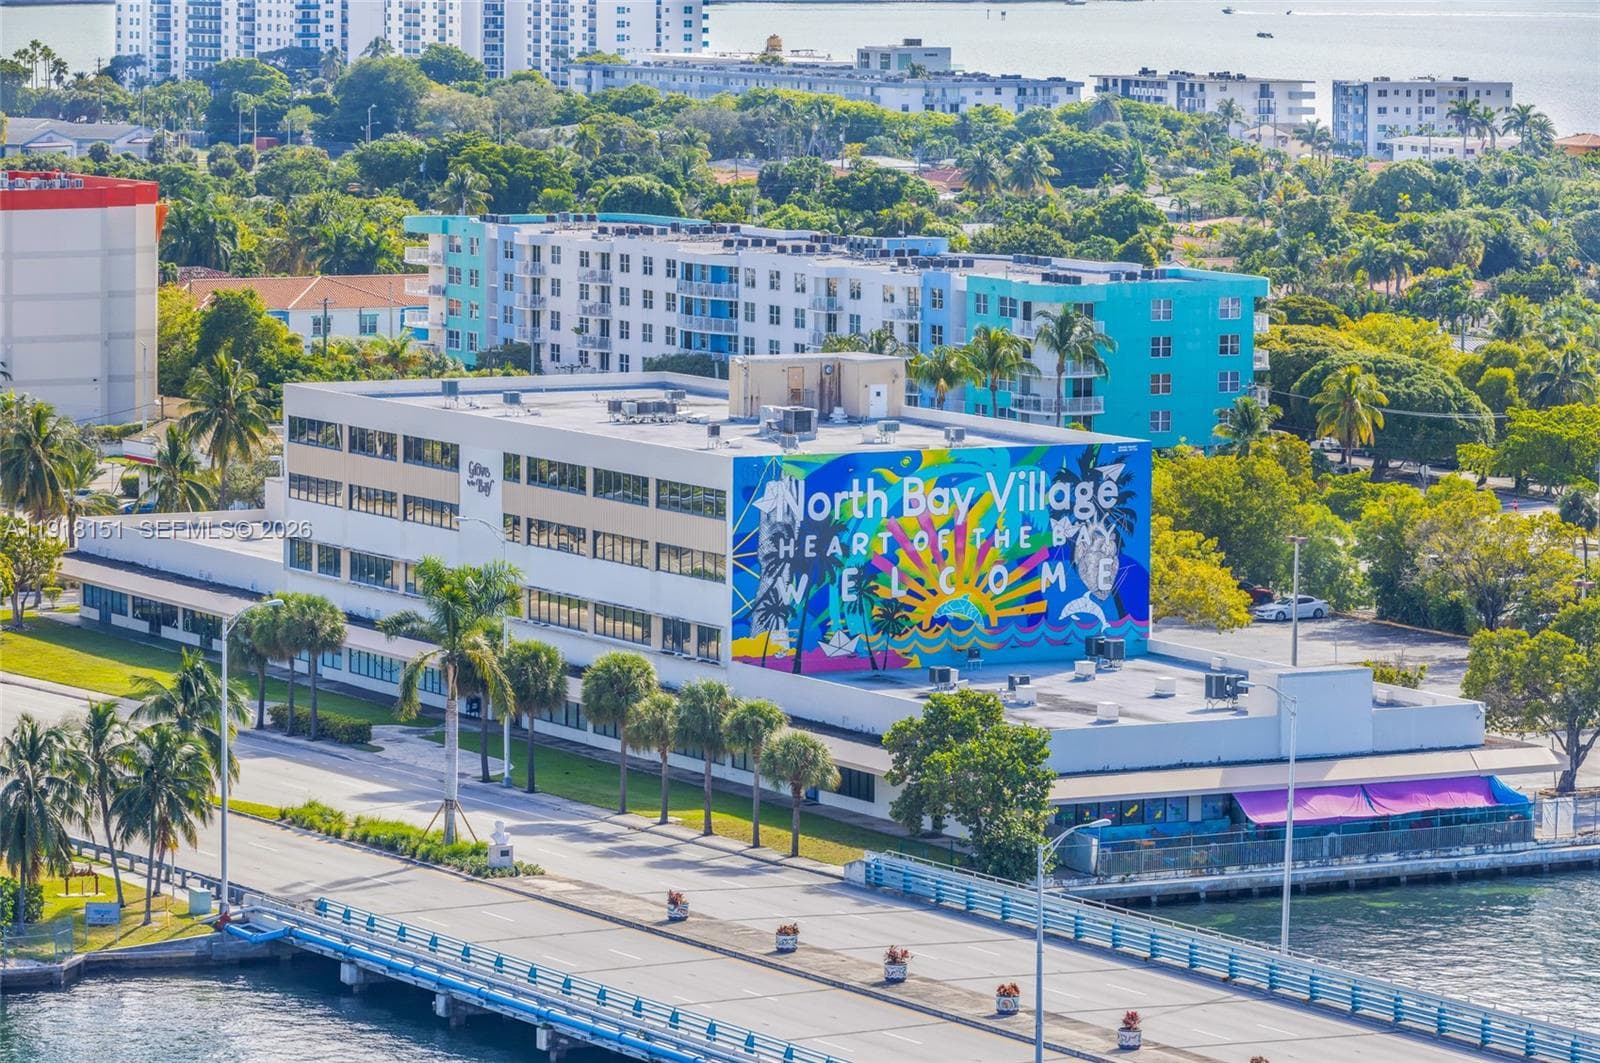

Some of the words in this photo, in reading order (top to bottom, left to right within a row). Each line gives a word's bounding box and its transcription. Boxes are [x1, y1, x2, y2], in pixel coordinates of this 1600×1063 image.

[776, 478, 888, 522] North
[903, 475, 974, 524] Bay
[986, 469, 1119, 520] Village
[779, 532, 892, 558] HEART
[913, 528, 949, 553] OF
[974, 525, 1031, 549] THE
[1053, 523, 1116, 547] BAY
[776, 559, 1114, 604] WELCOME
